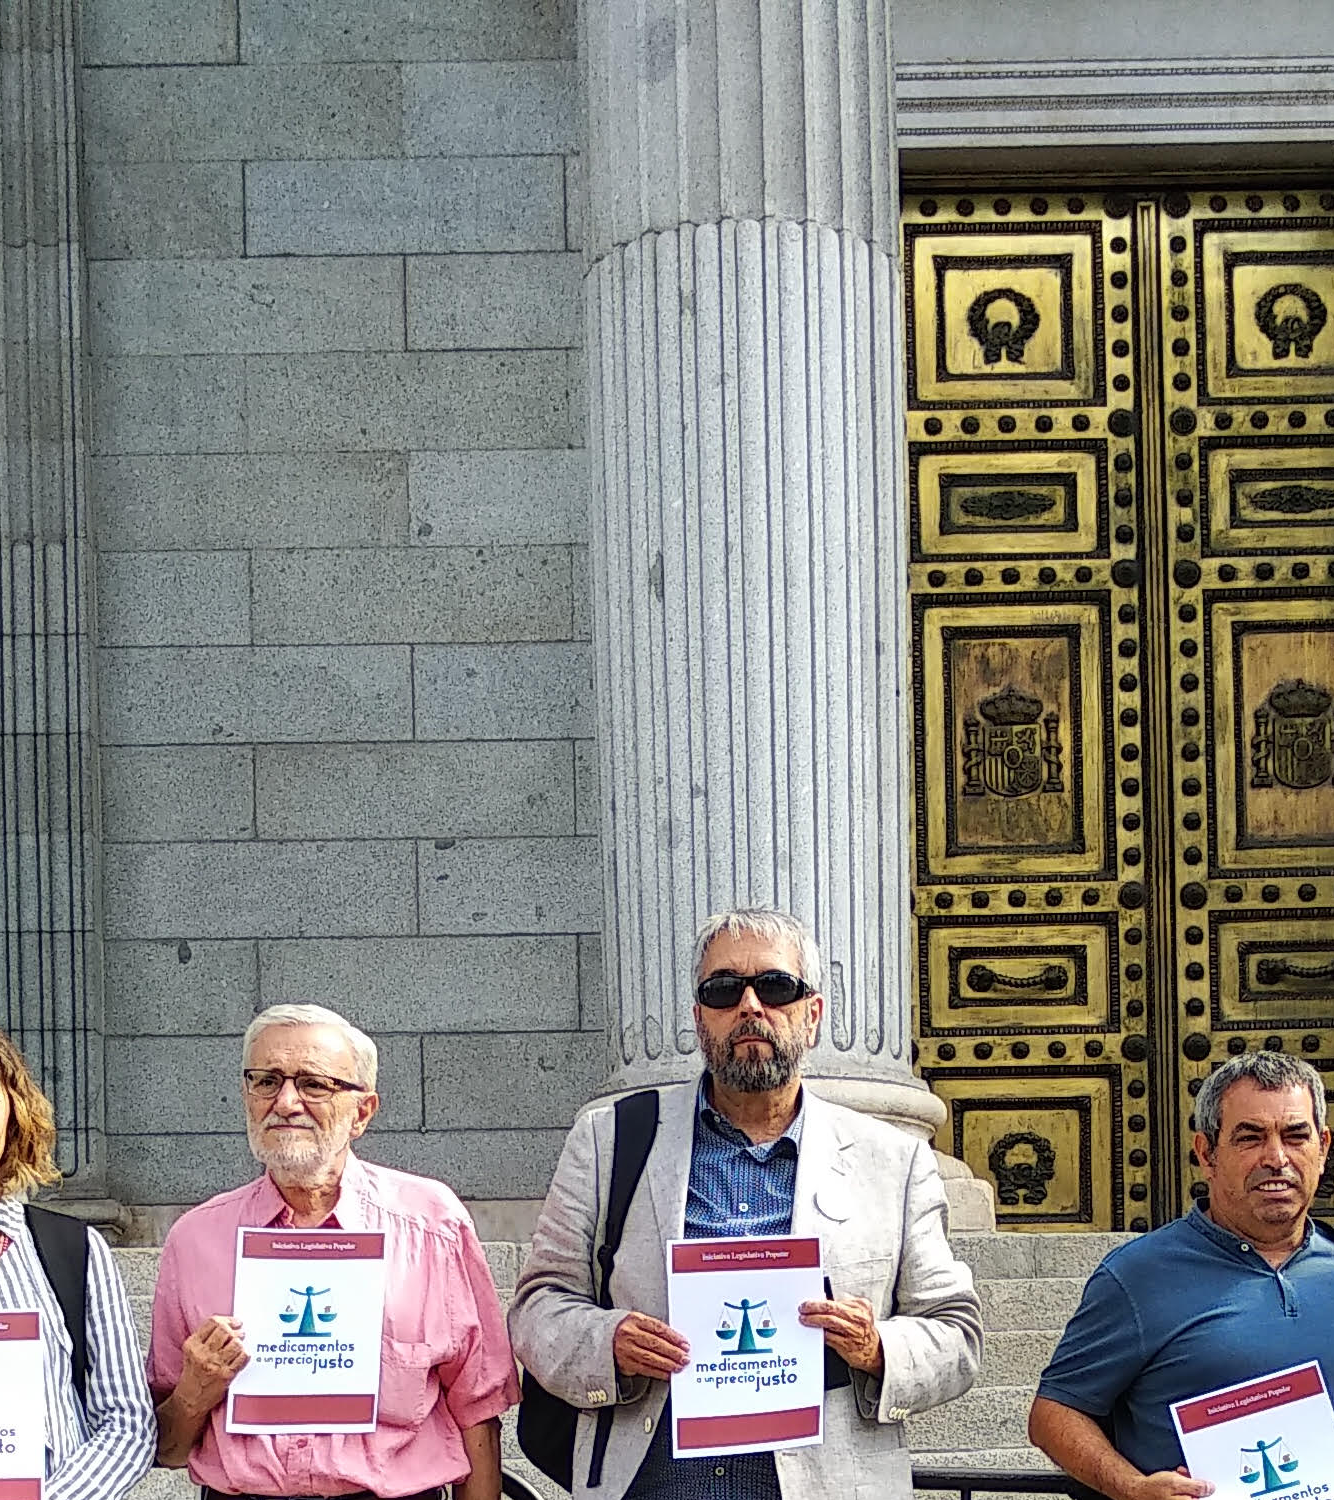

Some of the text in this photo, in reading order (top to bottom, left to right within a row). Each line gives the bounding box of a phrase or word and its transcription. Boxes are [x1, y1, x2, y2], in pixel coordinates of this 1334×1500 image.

[256, 1340, 355, 1352] medicamentos
[274, 1353, 313, 1369] precio
[312, 1353, 354, 1374] justo
[696, 1355, 798, 1372] medicamentos
[715, 1372, 755, 1389] precio
[755, 1369, 798, 1392] justo
